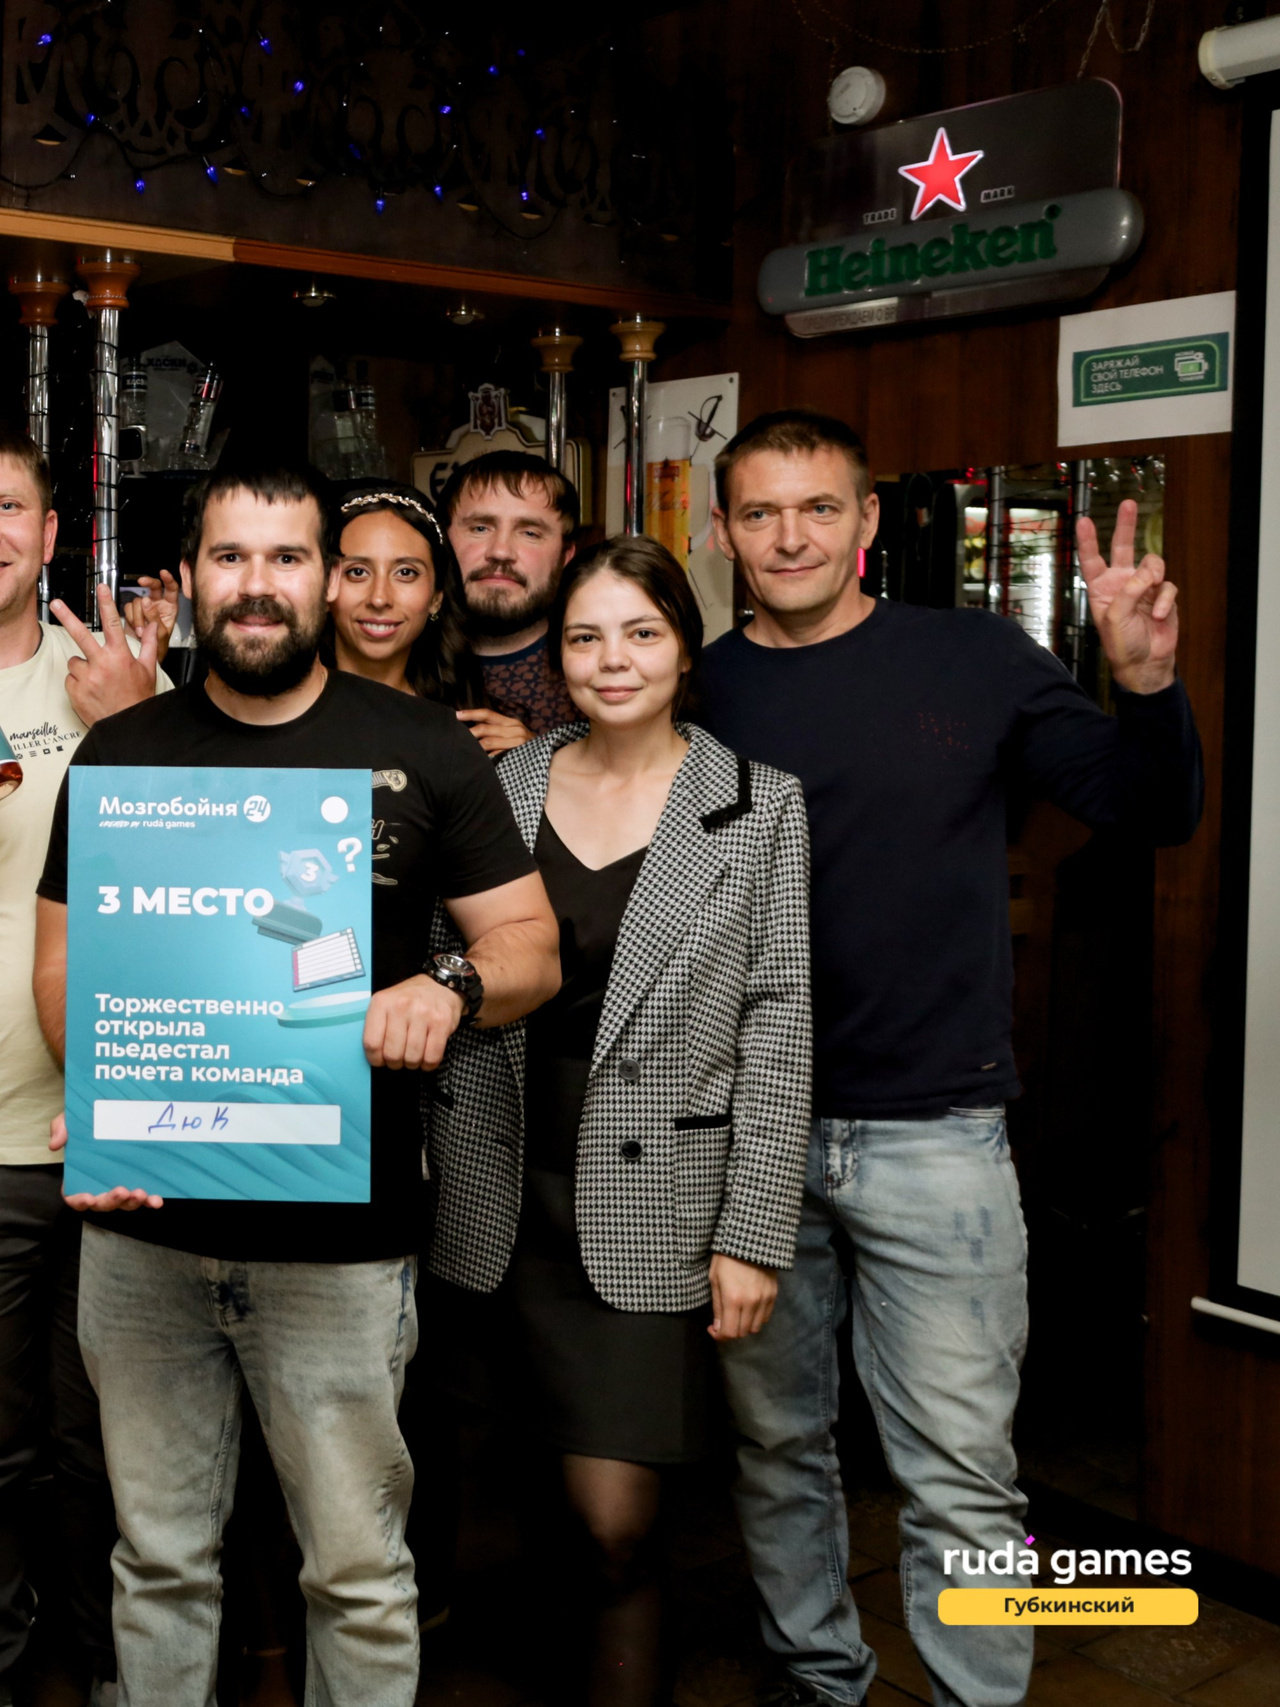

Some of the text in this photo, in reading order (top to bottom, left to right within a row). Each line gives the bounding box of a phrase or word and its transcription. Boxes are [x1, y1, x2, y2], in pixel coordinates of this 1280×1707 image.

[863, 186, 1014, 224] TRADE MARK
[804, 218, 1058, 297] Heineken
[1091, 356, 1140, 372] ЗАРЯЖАЙ
[1091, 370, 1118, 383] СВОЙ
[1119, 366, 1164, 379] ТЕЛЕФОН
[1091, 383, 1122, 394] ЗДЕСЬ
[11, 739, 41, 752] ILLER
[99, 796, 270, 819] Мозгобойня 24
[165, 820, 196, 830] games
[300, 862, 319, 882] 3
[97, 886, 275, 916] 3 МЕСТО
[95, 993, 284, 1017] Торжественно
[95, 1019, 206, 1039] открыла
[95, 1042, 230, 1060] пьедестал
[95, 1064, 304, 1086] почета команда
